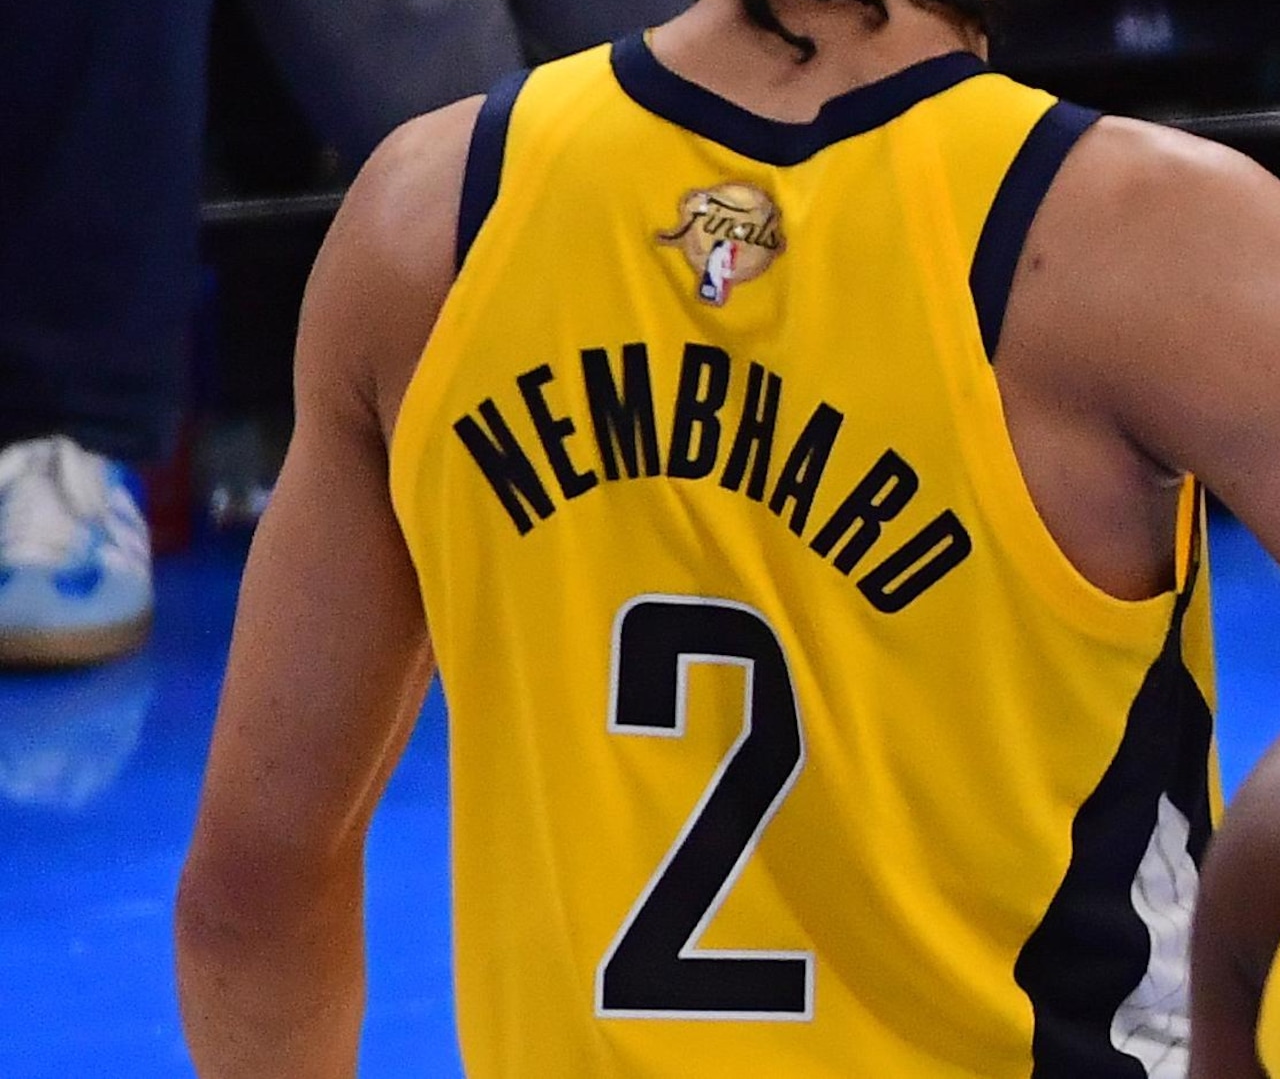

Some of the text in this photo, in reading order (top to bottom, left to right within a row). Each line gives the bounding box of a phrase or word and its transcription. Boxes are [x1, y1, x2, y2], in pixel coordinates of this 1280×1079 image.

[657, 196, 781, 251] Finals
[452, 342, 973, 615] NEMBHARD
[594, 592, 814, 1021] 2
